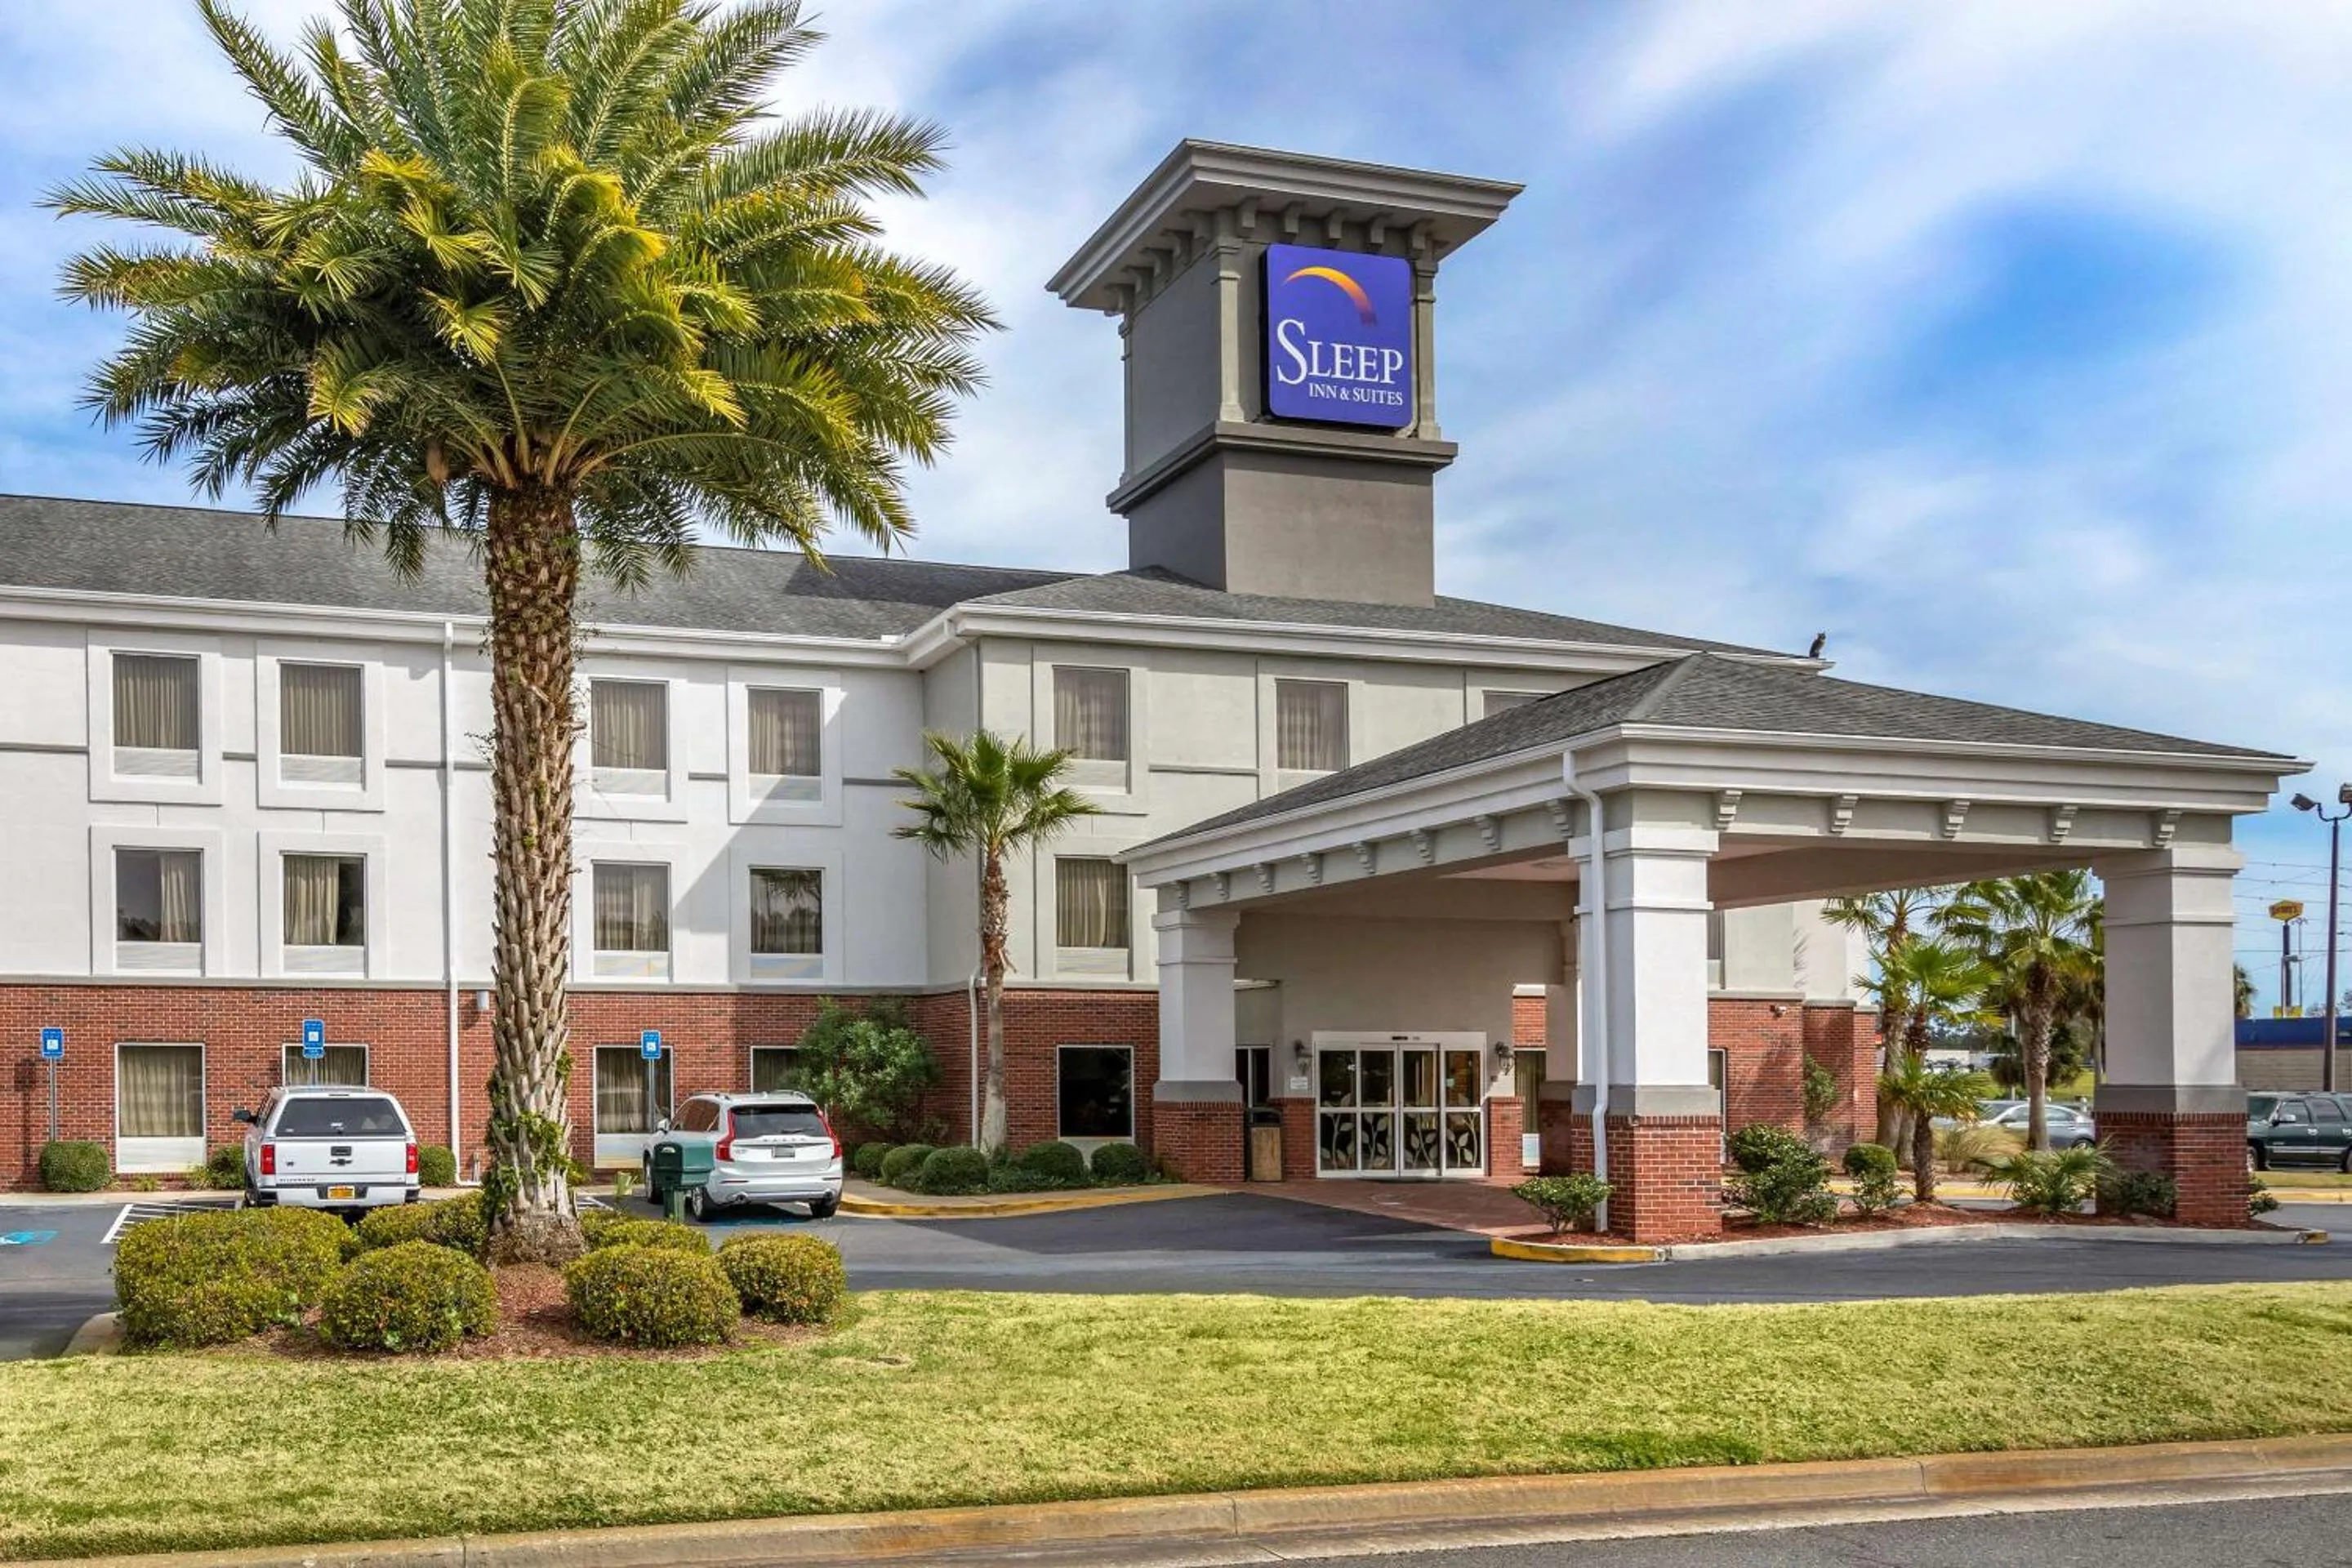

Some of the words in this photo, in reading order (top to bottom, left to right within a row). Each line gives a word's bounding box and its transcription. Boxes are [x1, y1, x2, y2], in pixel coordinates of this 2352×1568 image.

[1276, 318, 1403, 385] SLEEP
[1309, 383, 1336, 399] INN
[1340, 387, 1350, 400] &
[1353, 387, 1403, 405] SUITES
